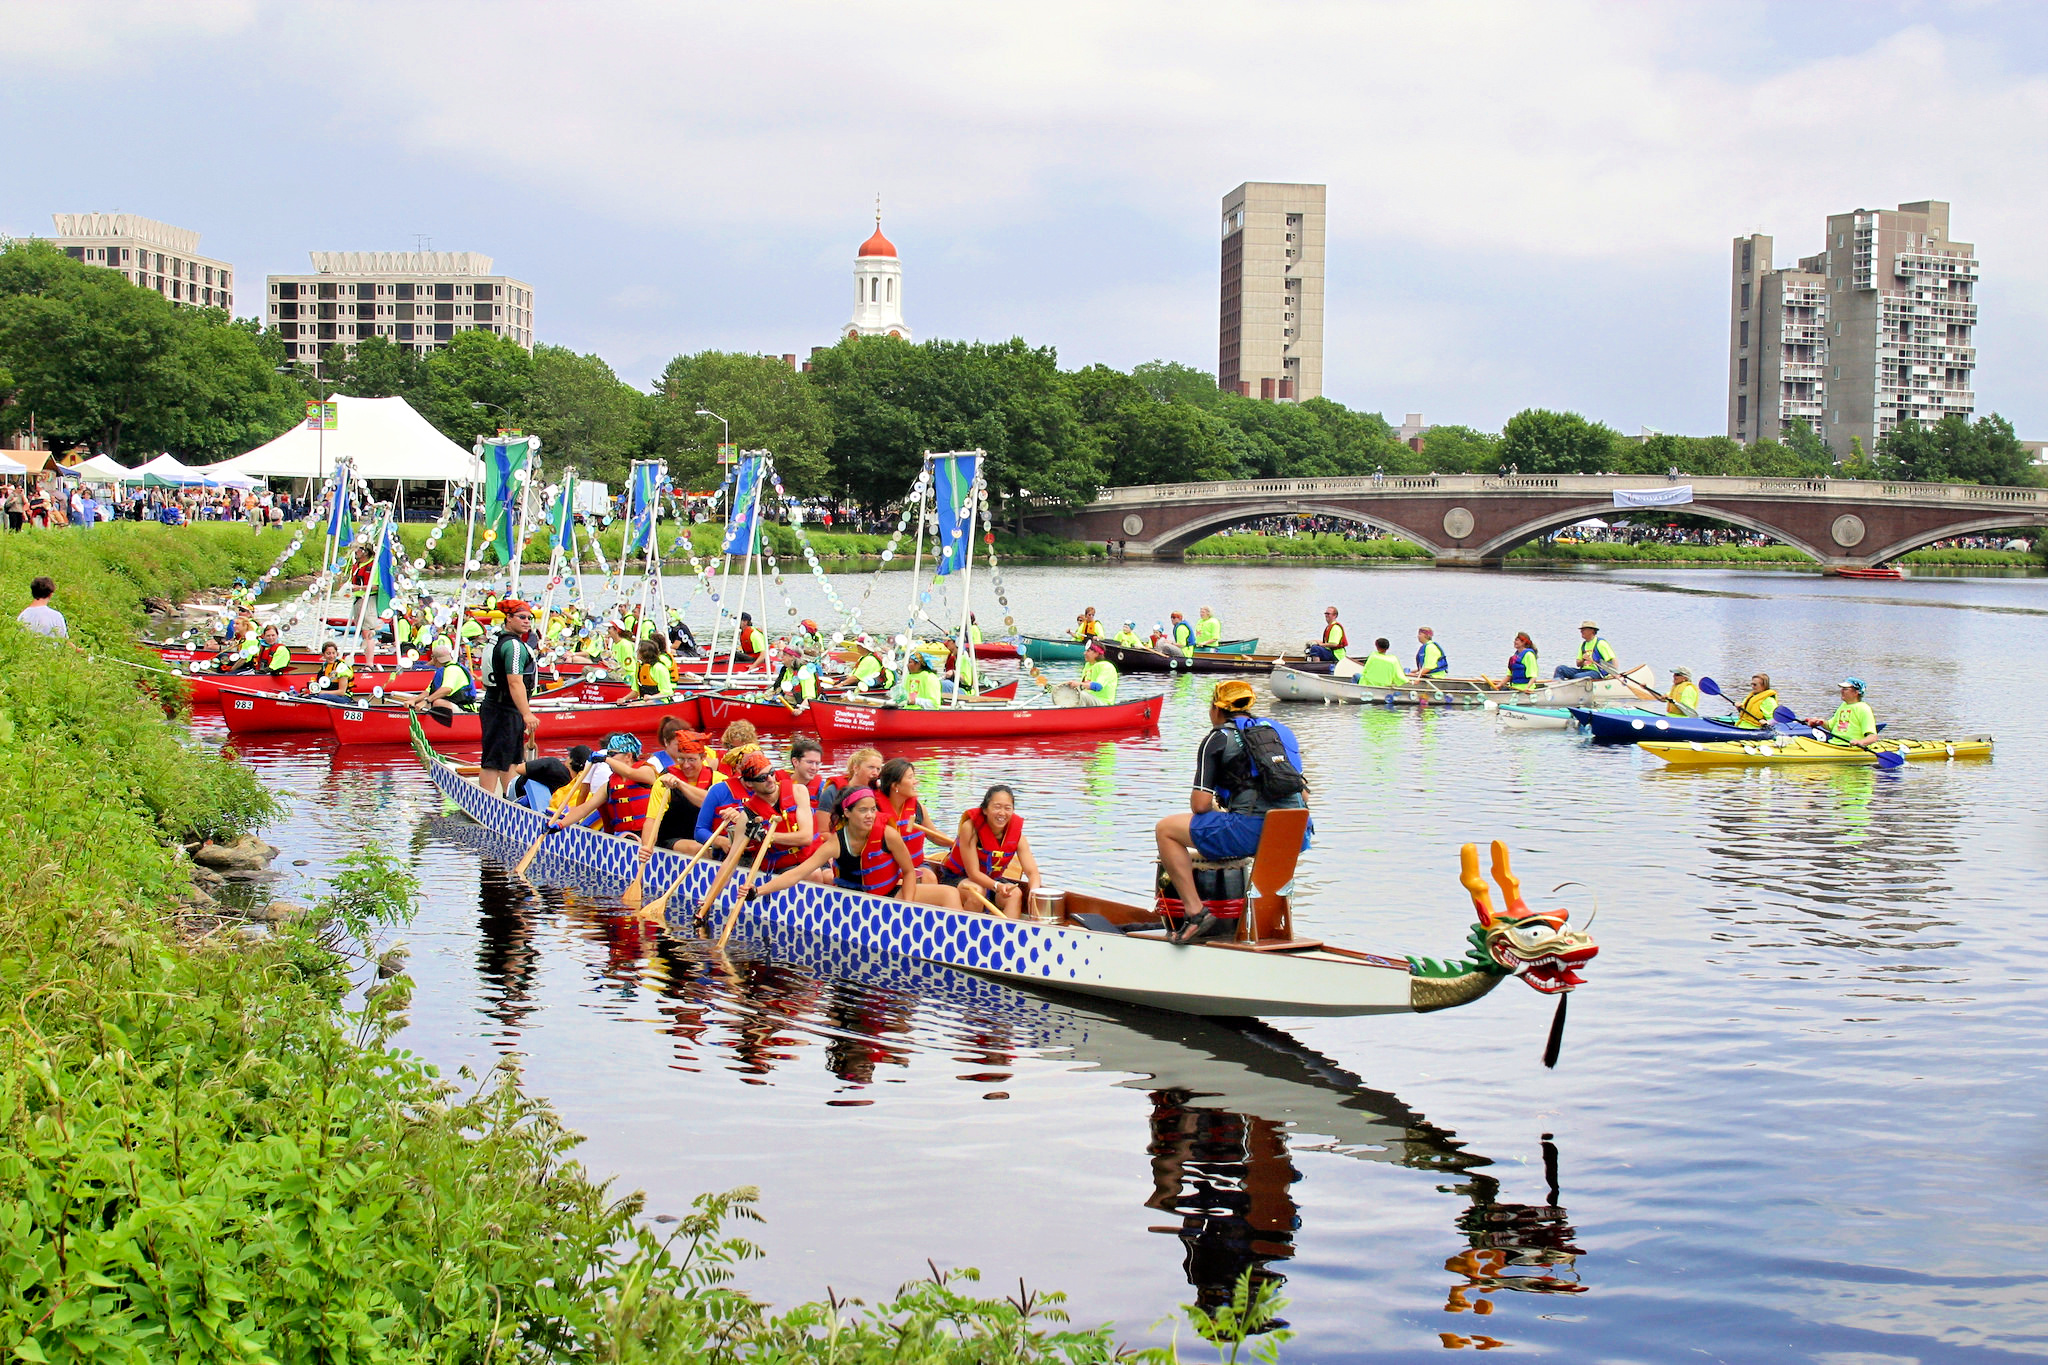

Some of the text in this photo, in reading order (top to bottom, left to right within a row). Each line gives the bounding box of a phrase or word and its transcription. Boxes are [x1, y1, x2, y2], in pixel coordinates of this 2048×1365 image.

[344, 710, 363, 721] 988
[835, 710, 871, 720] Charles River
[834, 716, 852, 724] Canoe
[858, 719, 875, 727] Kayak
